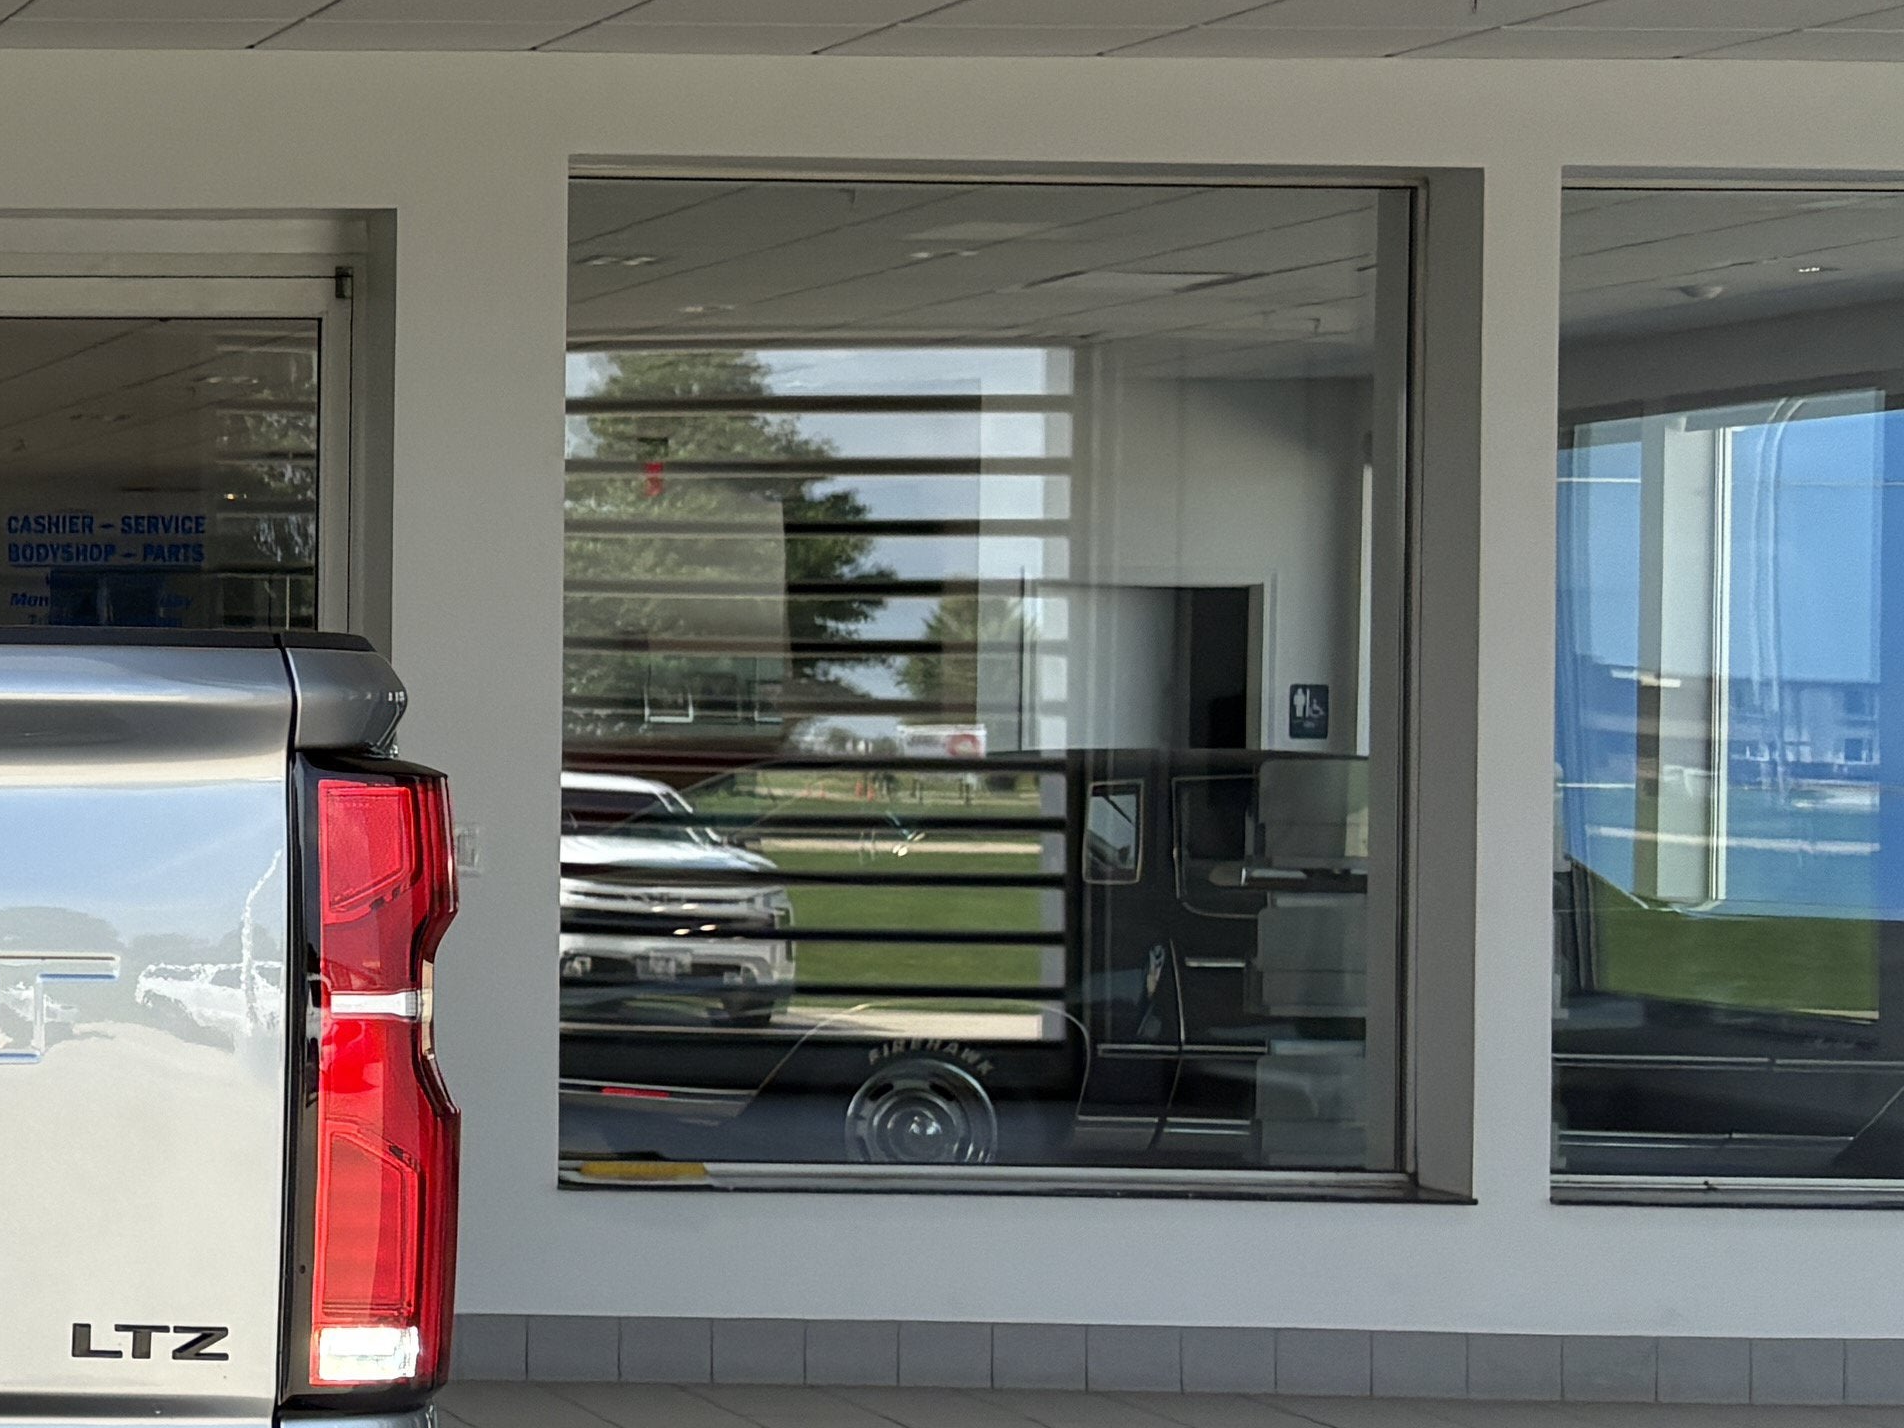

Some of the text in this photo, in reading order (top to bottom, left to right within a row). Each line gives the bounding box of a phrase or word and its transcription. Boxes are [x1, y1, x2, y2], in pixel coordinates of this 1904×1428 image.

[7, 515, 94, 534] CASHIER
[121, 515, 206, 534] SERVICE
[7, 543, 118, 562] BODYSHOP
[143, 543, 205, 563] PARTS
[71, 1322, 229, 1361] LTZ
